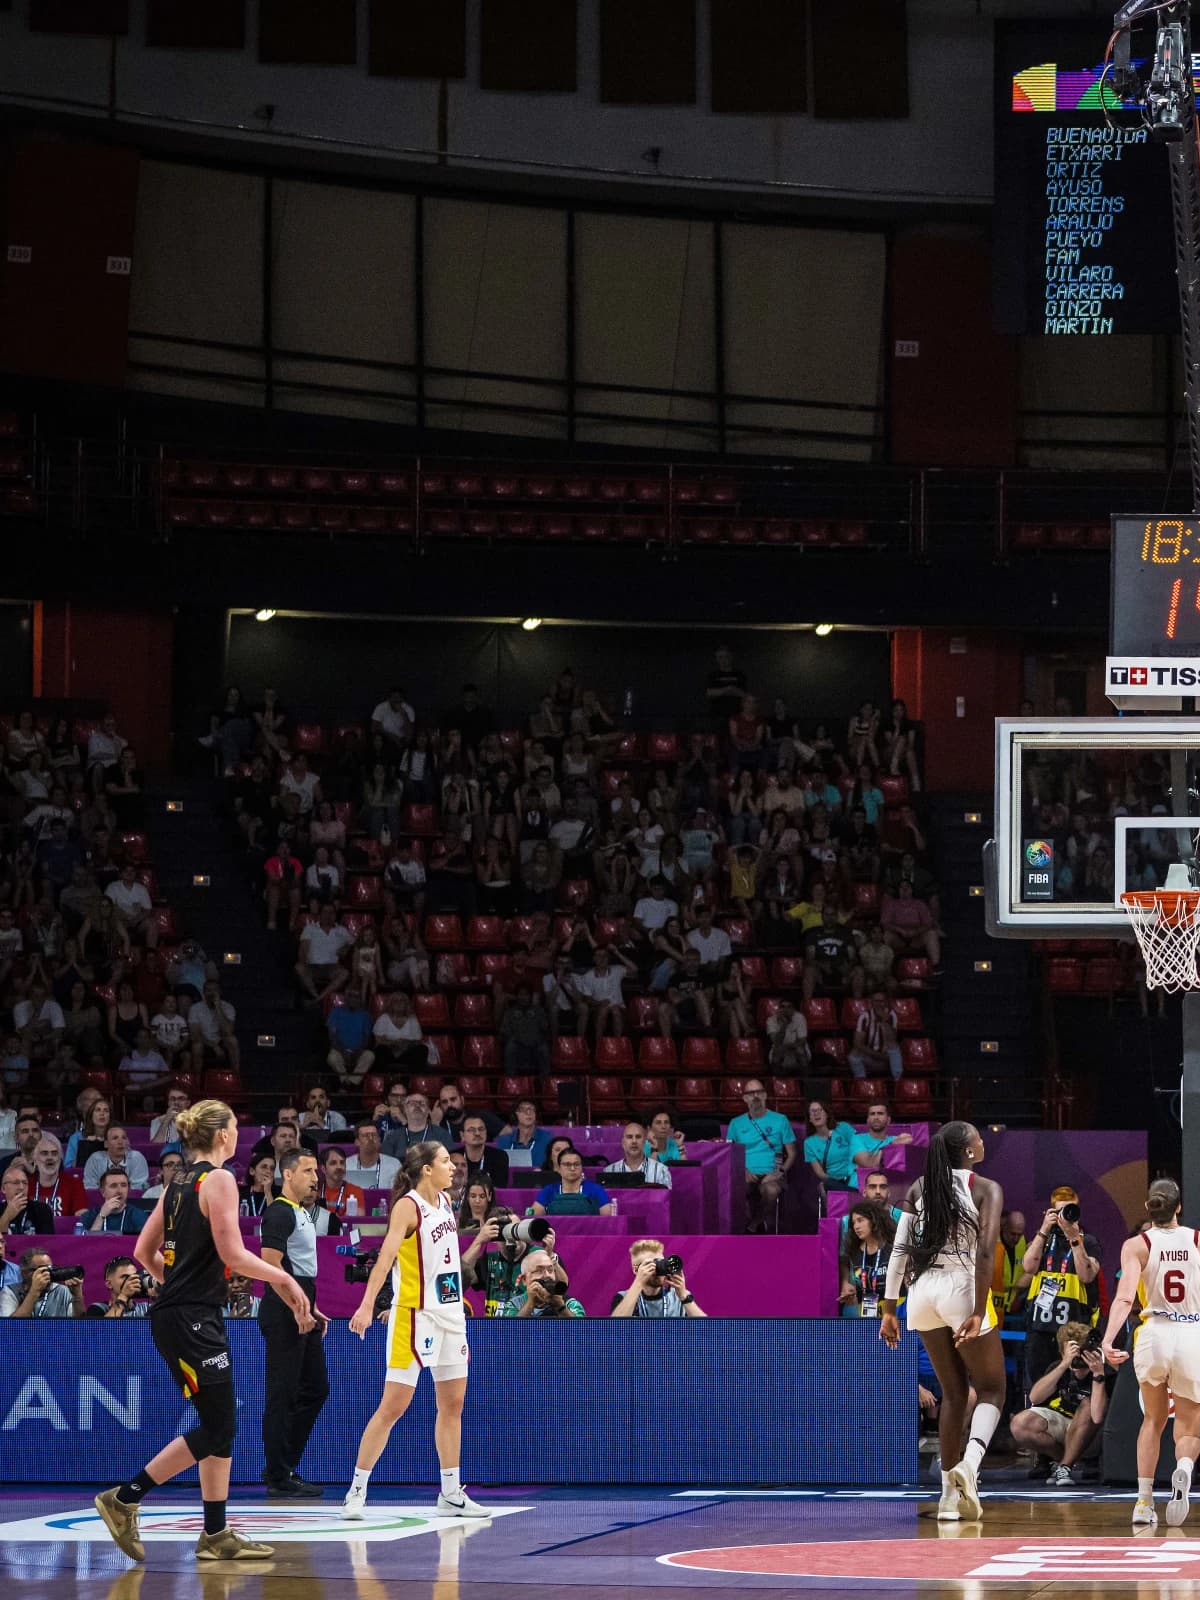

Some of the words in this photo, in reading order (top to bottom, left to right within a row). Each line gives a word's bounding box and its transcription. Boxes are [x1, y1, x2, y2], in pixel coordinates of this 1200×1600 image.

[1046, 127, 1148, 144] BUENAVIDA
[1046, 144, 1123, 161] ETXARRI
[1046, 161, 1102, 178] ORTIZ
[1046, 179, 1102, 195] AYUSO
[1047, 196, 1125, 213] TORRENS
[1046, 213, 1113, 230] ARAUJO
[1046, 231, 1102, 247] PUEYO
[1045, 248, 1080, 265] FAM
[1045, 265, 1114, 282] VILARO
[1045, 282, 1125, 300] CARRERA
[1045, 300, 1102, 317] GINZO
[1044, 317, 1113, 334] MARTIN
[1028, 873, 1049, 884] FIBA
[1160, 1249, 1189, 1262] AYUSO
[1164, 1269, 1186, 1304] 6
